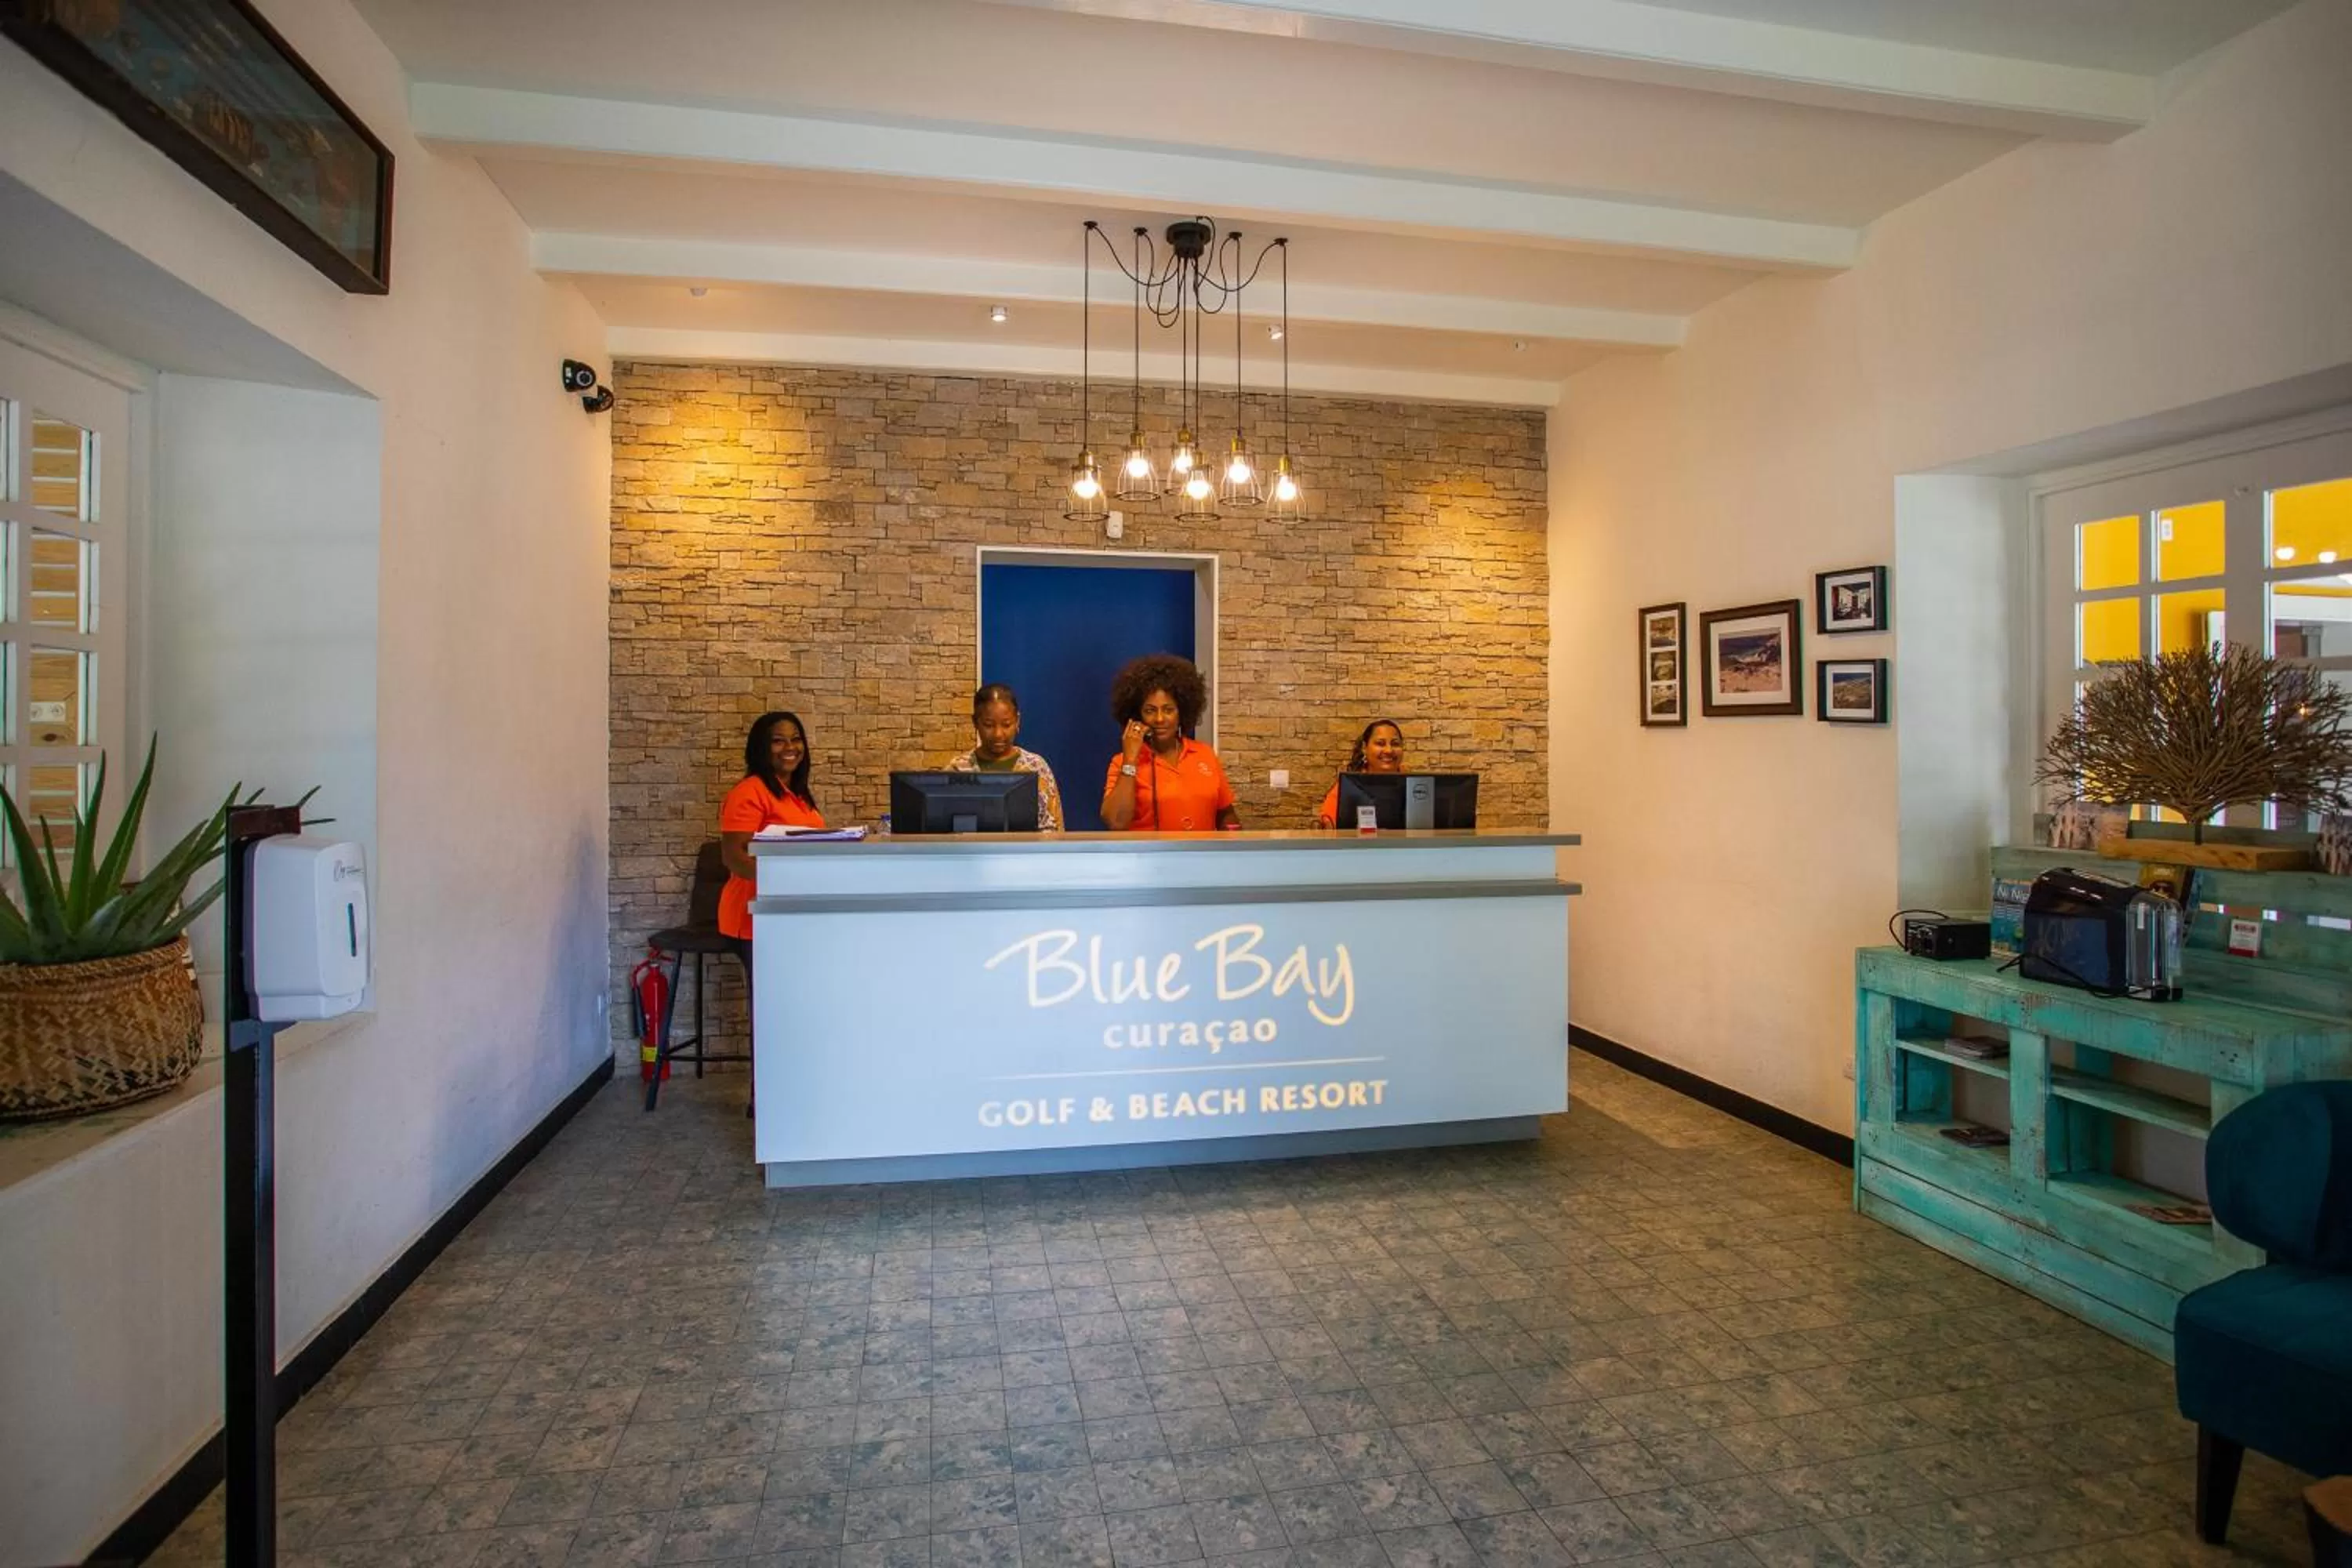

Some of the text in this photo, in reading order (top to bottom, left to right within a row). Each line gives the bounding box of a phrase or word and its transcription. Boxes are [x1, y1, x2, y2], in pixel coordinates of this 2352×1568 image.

[983, 924, 1355, 1026] Blue Bay
[1103, 1018, 1278, 1054] curaçao
[978, 1080, 1388, 1127] GOLF & BEACH RESORT
